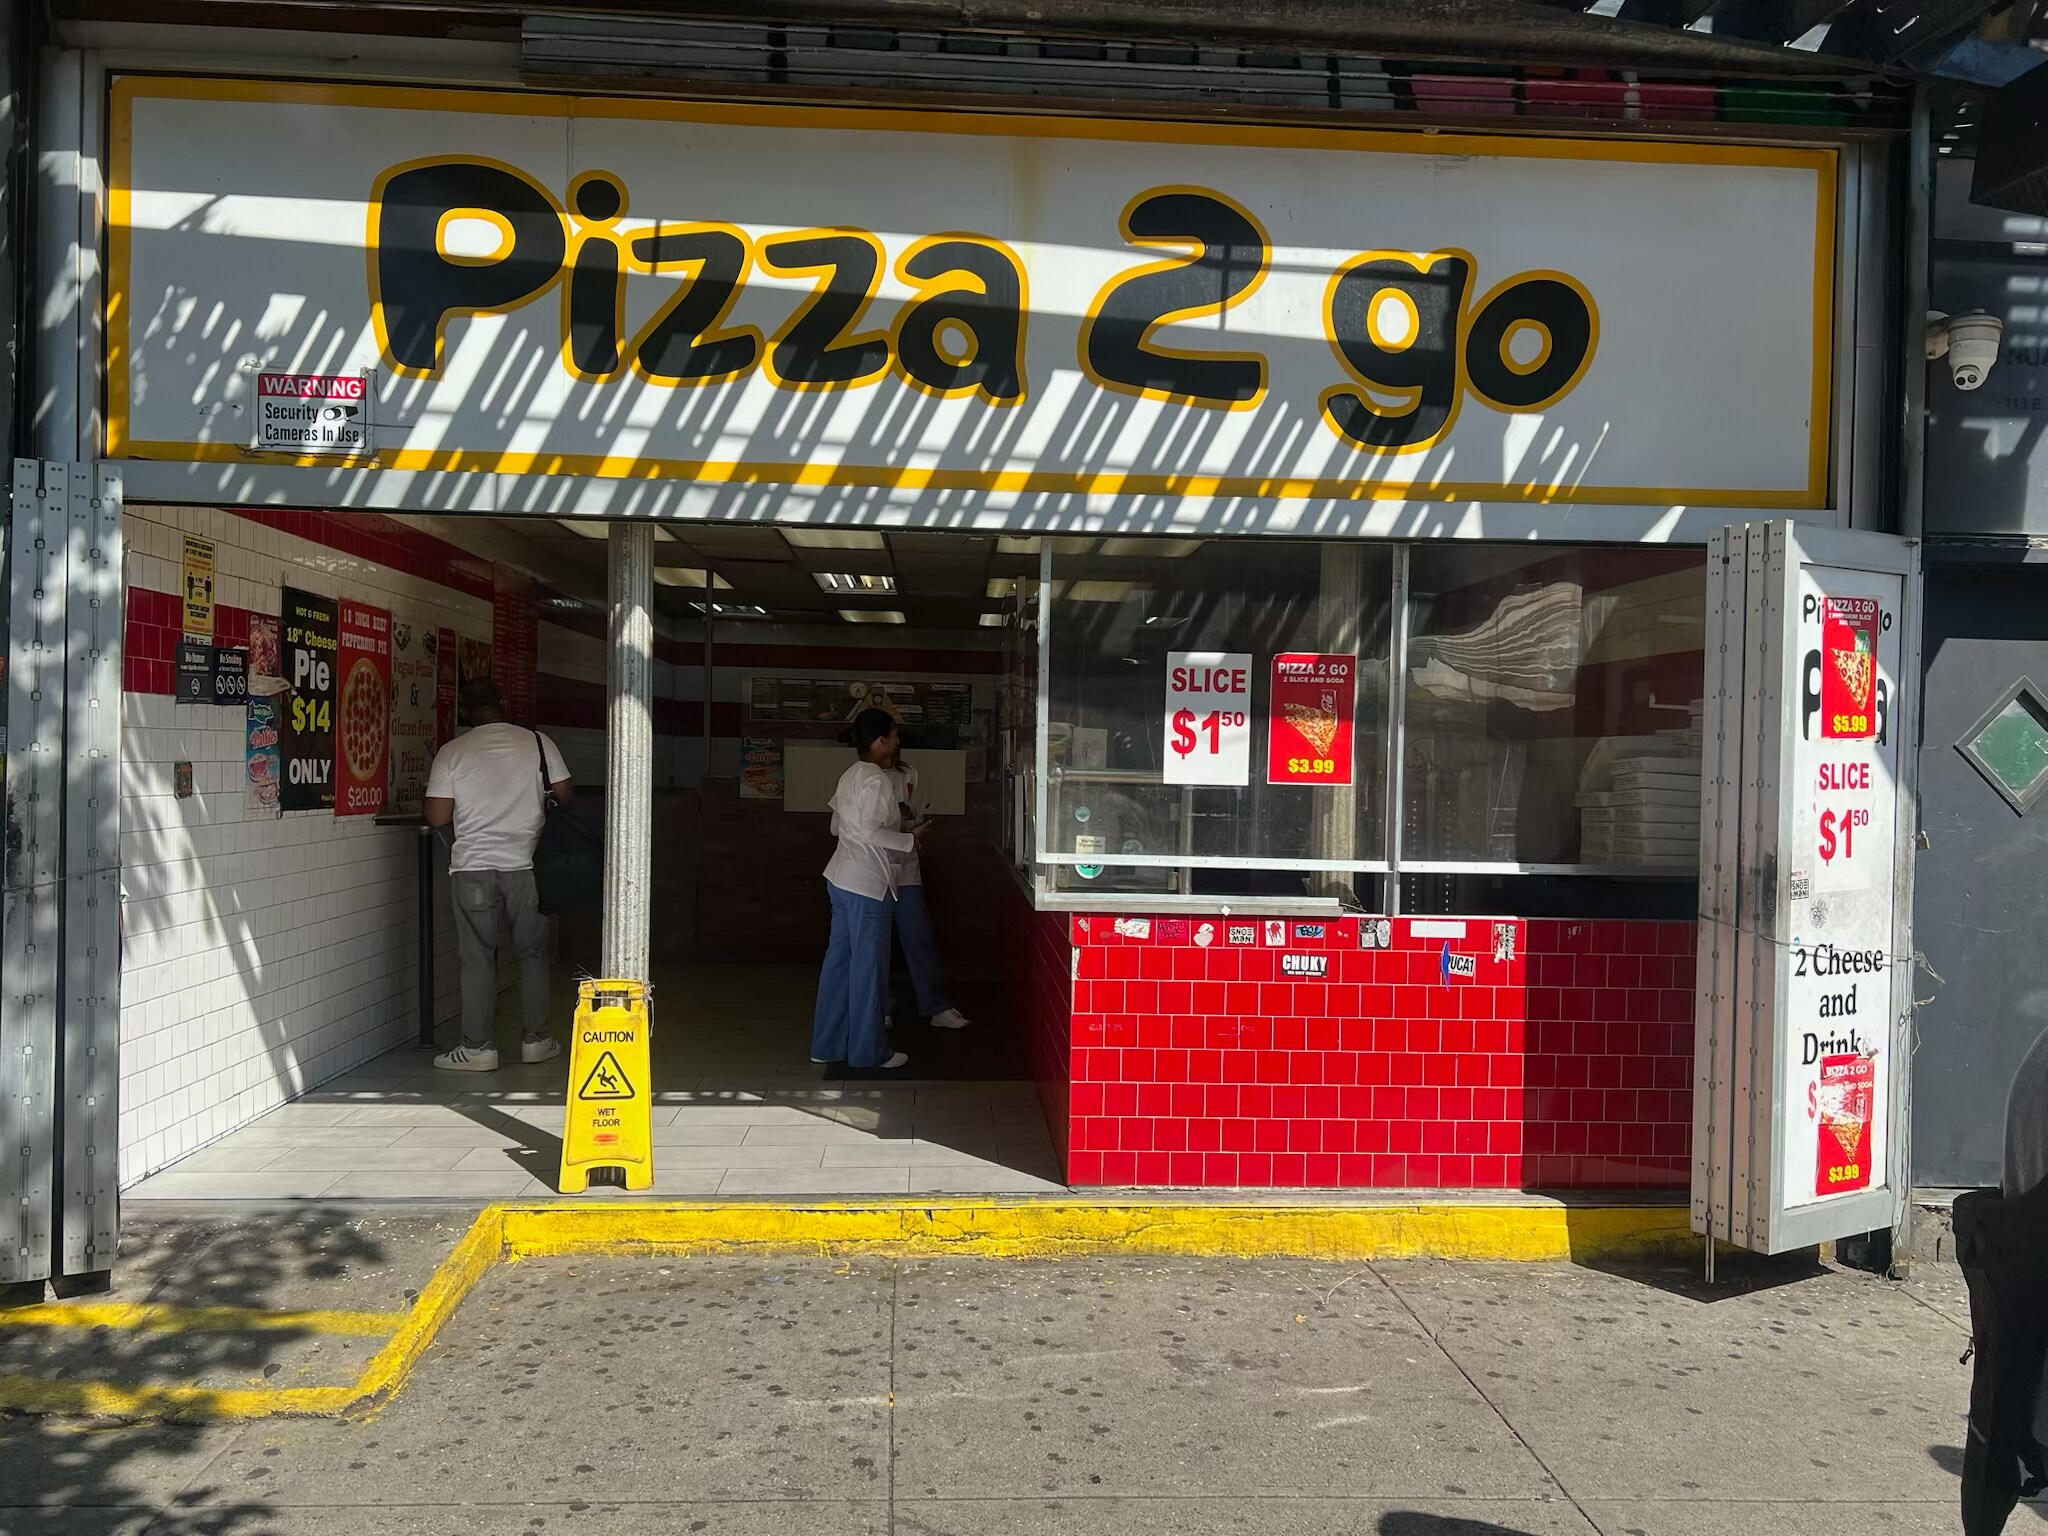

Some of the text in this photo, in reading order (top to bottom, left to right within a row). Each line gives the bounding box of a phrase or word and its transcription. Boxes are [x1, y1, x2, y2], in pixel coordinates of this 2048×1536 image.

[367, 154, 1599, 456] Pizza 2 go
[264, 377, 361, 398] WARNING
[265, 402, 319, 423] Security
[265, 423, 359, 442] Cameras In Use
[296, 606, 307, 617] HOT
[313, 610, 330, 623] FRESH
[1827, 599, 1875, 613] PIZZA 2 GO
[305, 630, 337, 651] Cheese
[294, 648, 330, 692] Pie
[393, 657, 414, 680] Vegan
[1278, 662, 1348, 676] PIZZA 2 GO
[1171, 667, 1246, 693] SLICE
[410, 682, 419, 707] &
[291, 695, 331, 736] $14
[392, 716, 417, 736] Gluten
[1833, 714, 1867, 733] $5.99
[288, 758, 331, 784] ONLY
[401, 751, 425, 773] Pizza
[1288, 757, 1335, 774] $3.99
[1818, 763, 1869, 790] SLICE
[347, 786, 382, 809] $20.00
[1282, 954, 1328, 971] CHUKY
[1795, 943, 1883, 977] 2 Cheese
[1819, 983, 1857, 1018] and
[583, 1031, 634, 1043] CAUTION
[1826, 1064, 1868, 1077] PIZZA 2 GO
[1857, 1081, 1873, 1090] SODA
[592, 1118, 620, 1127] FLOOR
[597, 1108, 616, 1116] WET
[1828, 1164, 1860, 1183] $3.99
